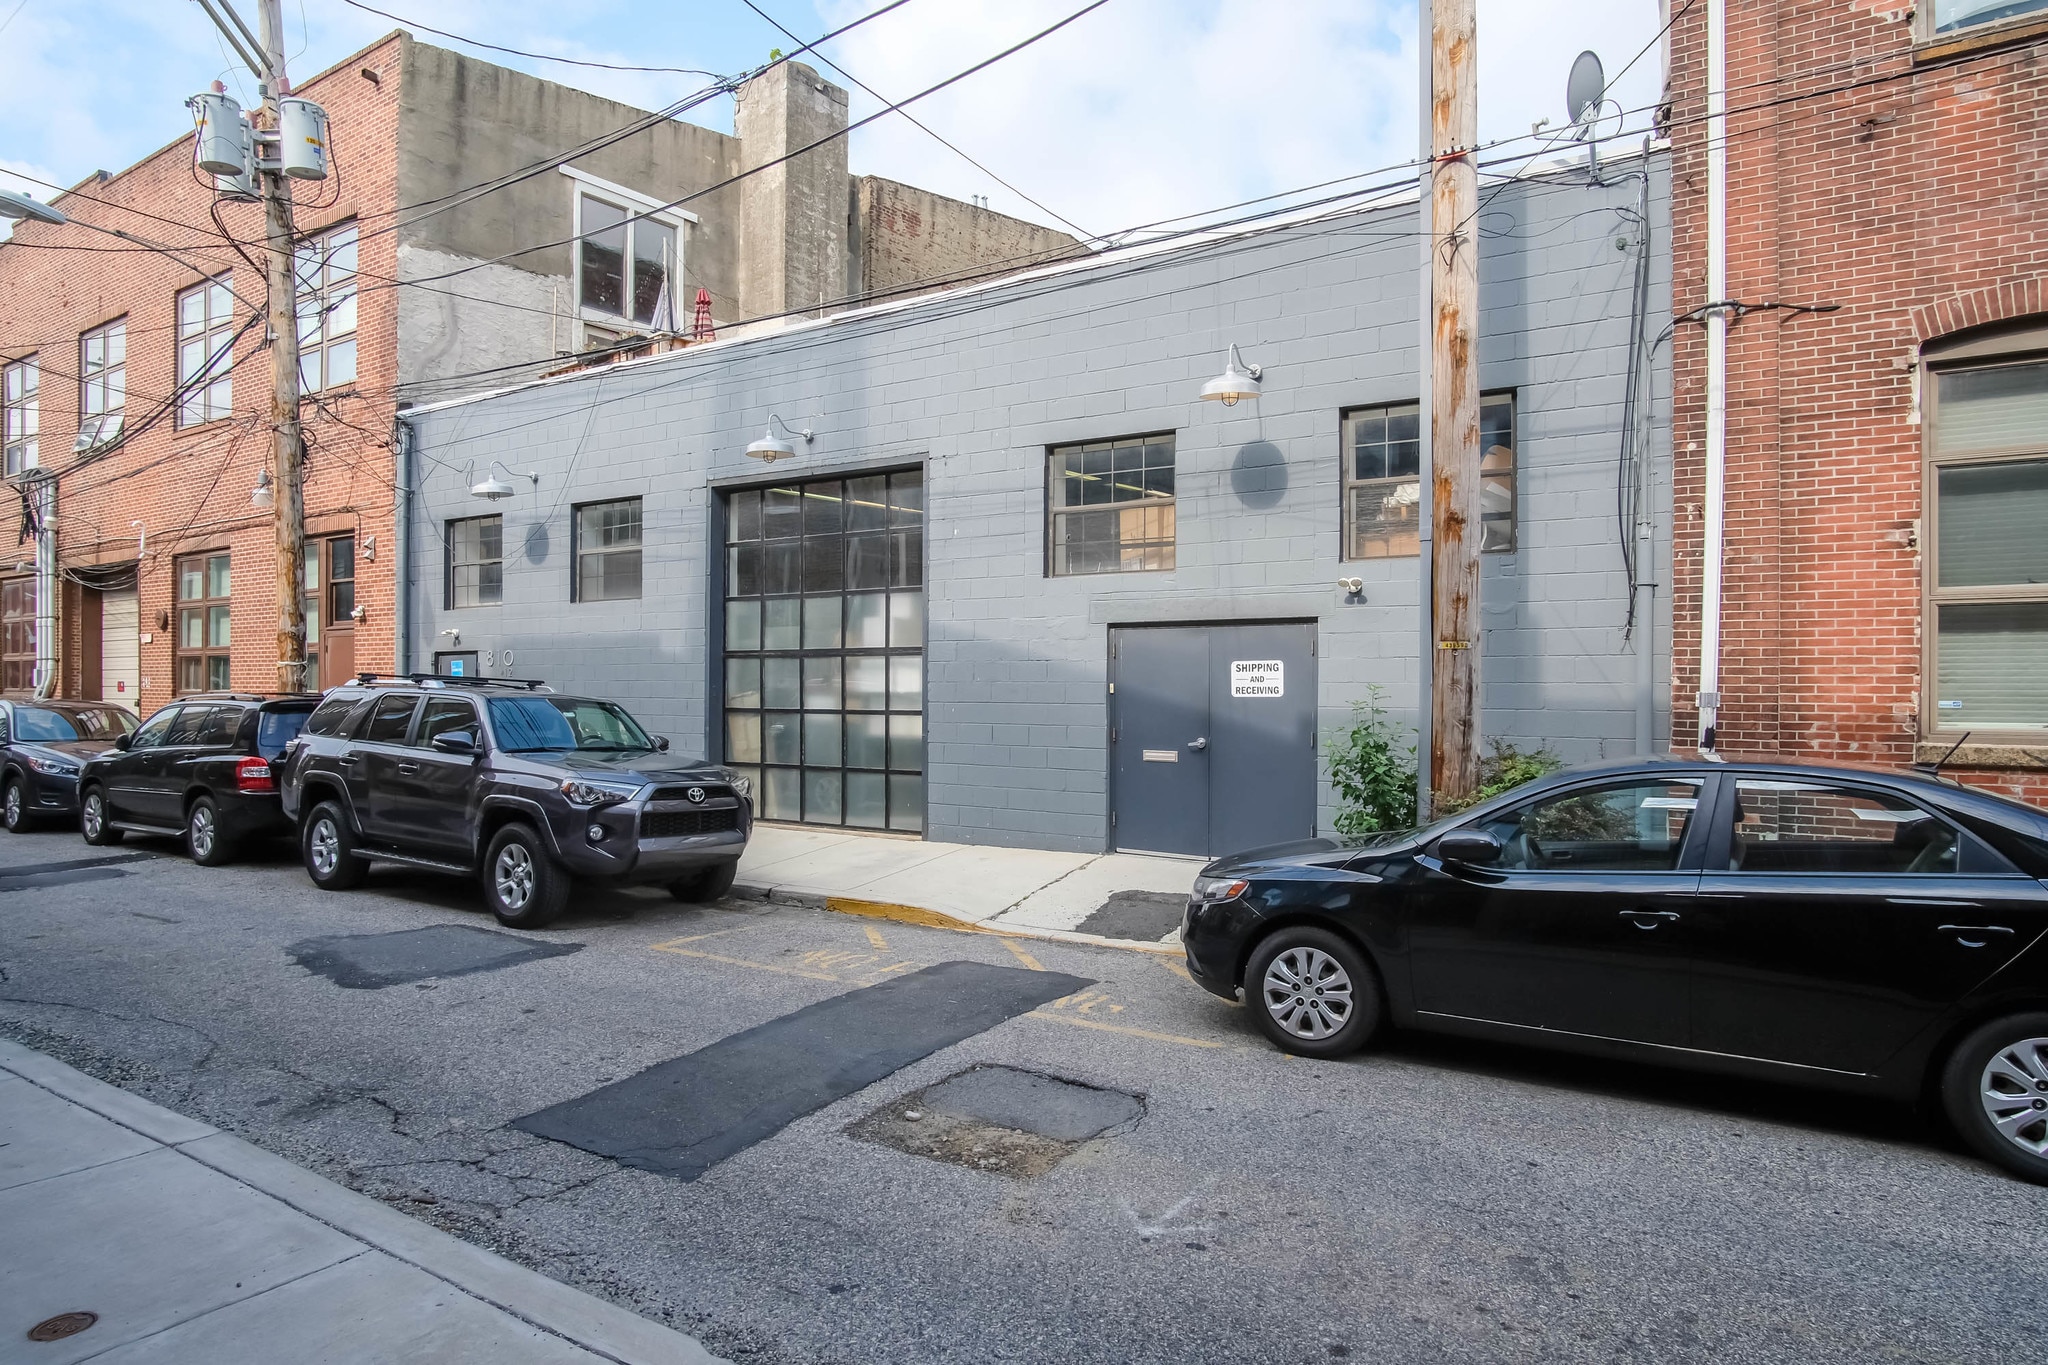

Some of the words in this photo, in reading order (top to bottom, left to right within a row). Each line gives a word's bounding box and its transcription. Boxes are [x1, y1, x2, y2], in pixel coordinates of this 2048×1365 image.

[1235, 663, 1279, 673] SHIPPING
[1249, 675, 1265, 683] AND
[1235, 685, 1280, 695] RECEIVING
